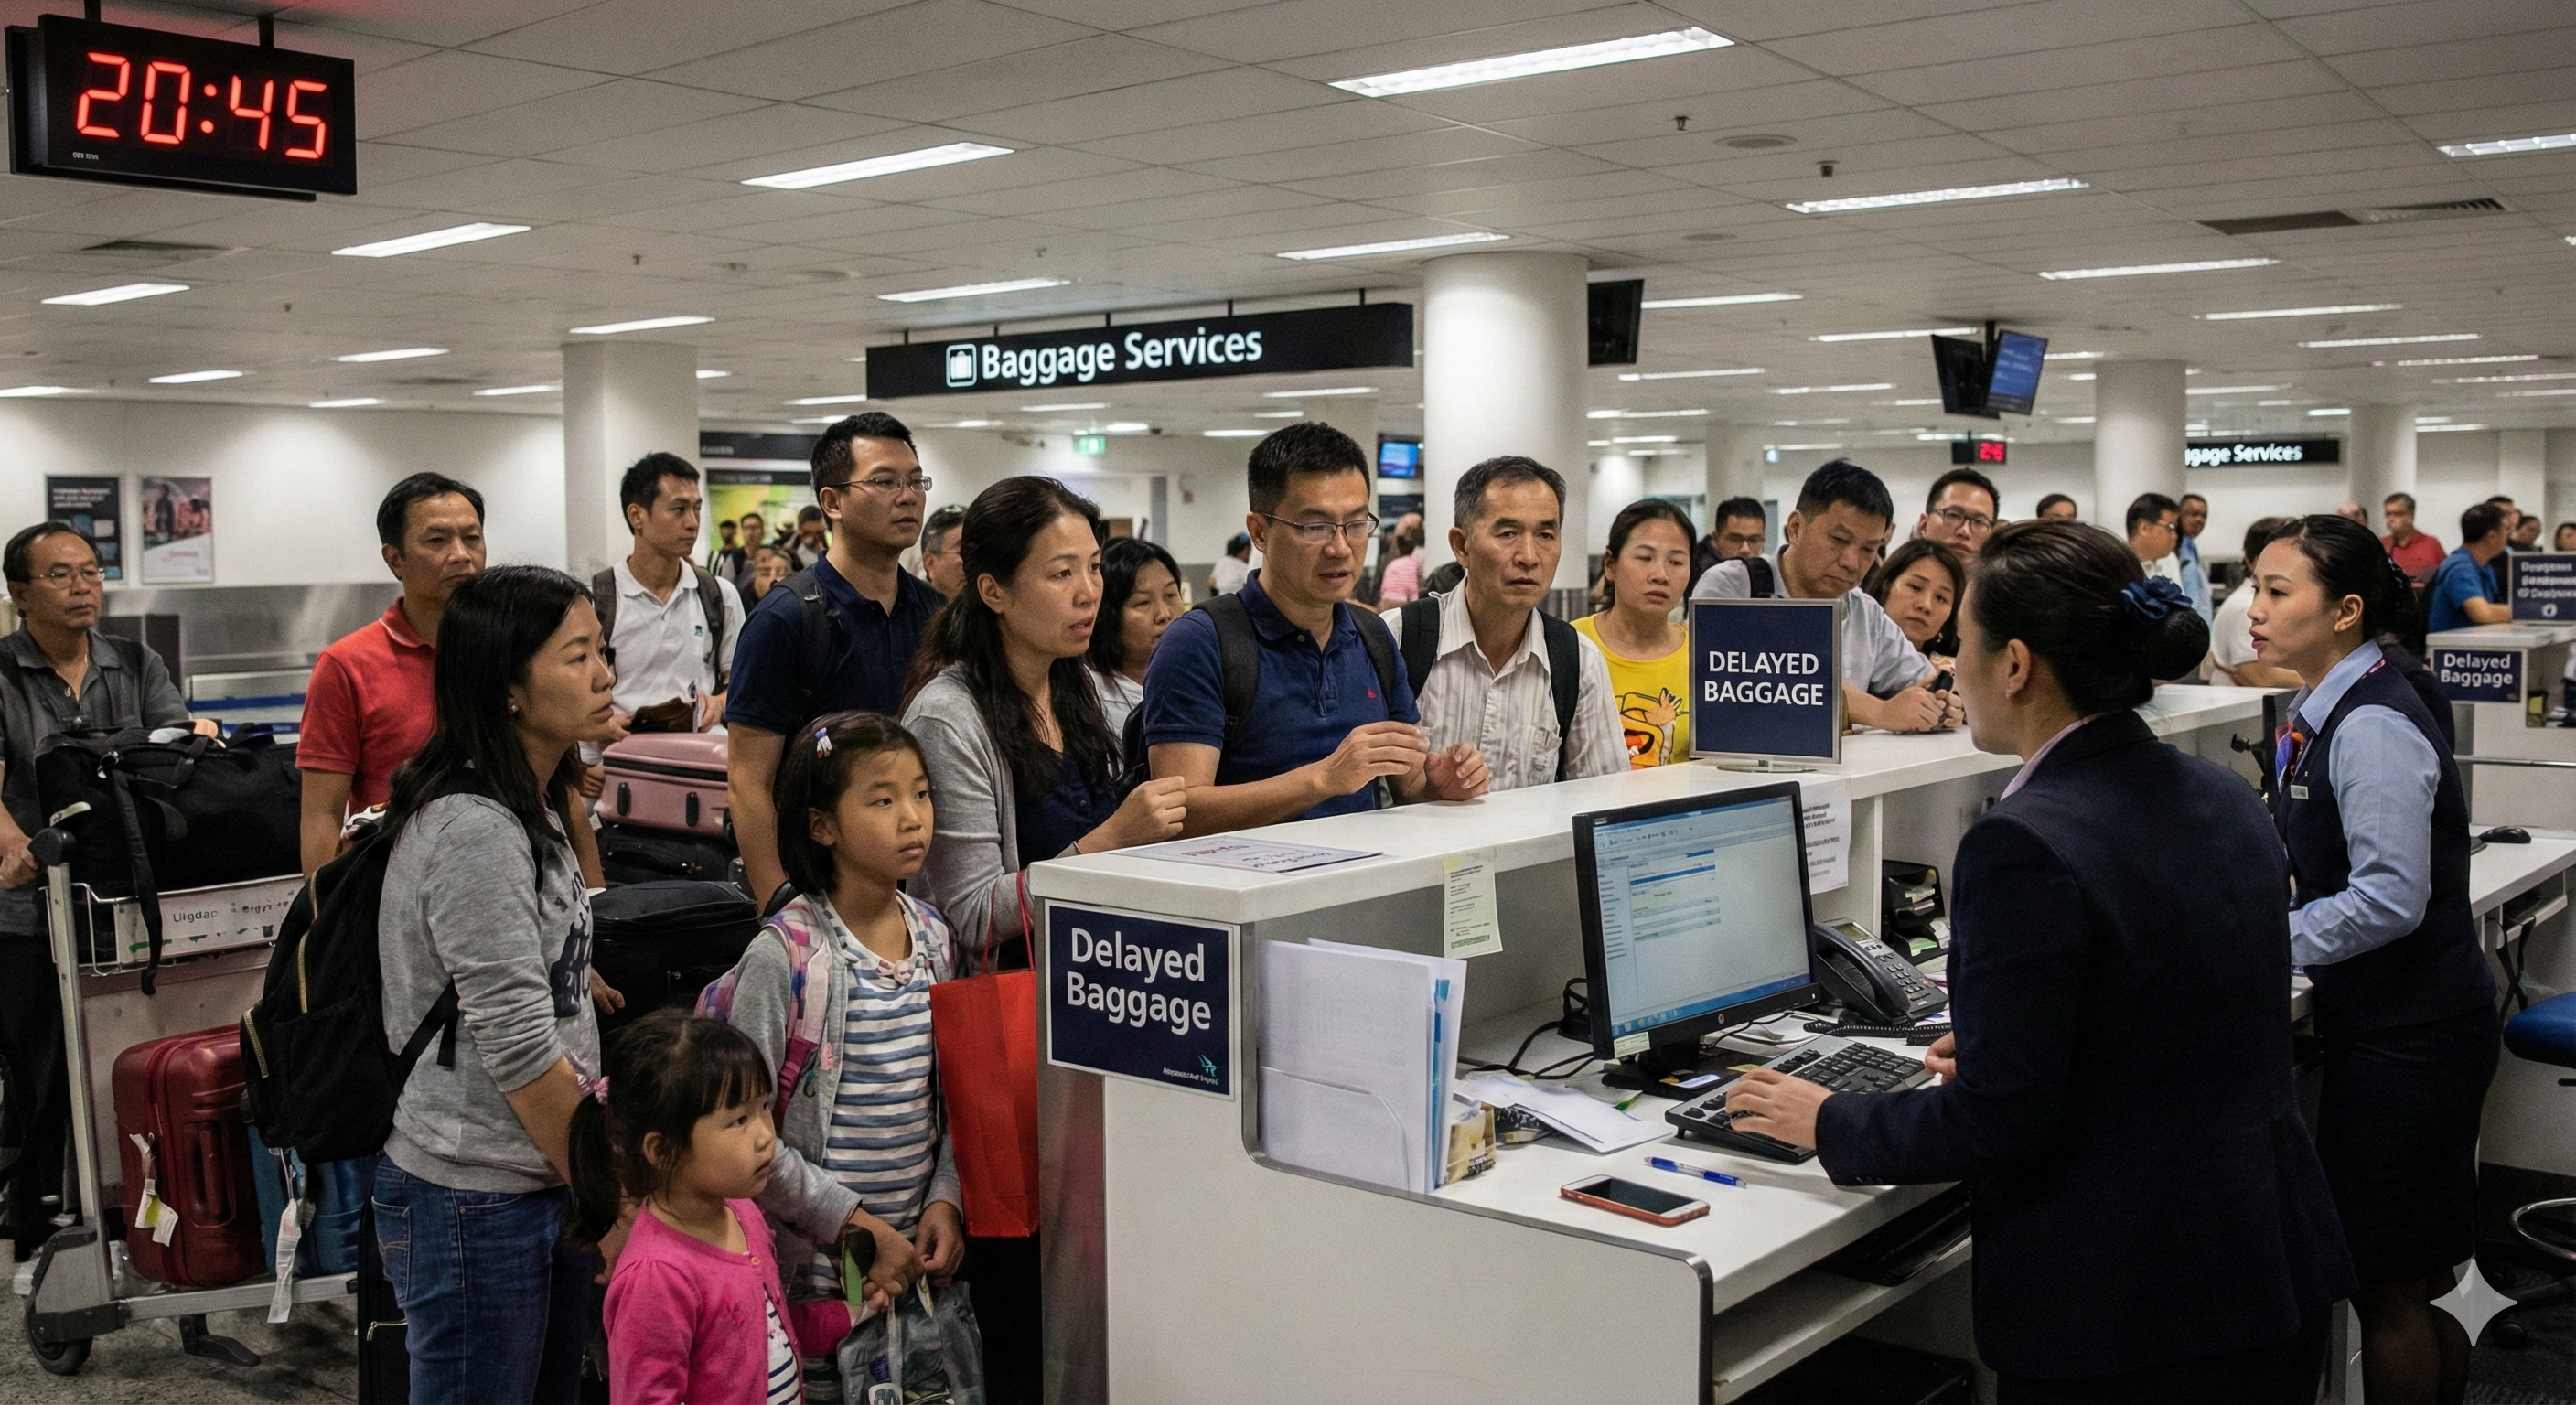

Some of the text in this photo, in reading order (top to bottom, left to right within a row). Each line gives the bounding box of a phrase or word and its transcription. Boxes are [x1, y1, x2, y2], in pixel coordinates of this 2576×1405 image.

[76, 52, 327, 159] 20:45
[982, 327, 1262, 386] Baggage Services
[2233, 443, 2303, 462] Services
[1709, 650, 1819, 675] DELAYED
[2443, 653, 2511, 672] Delayed
[2440, 669, 2513, 688] Baggage
[1704, 680, 1824, 706] BAGGAGE
[1071, 927, 1205, 984] Delayed
[1067, 971, 1212, 1035] Baggage
